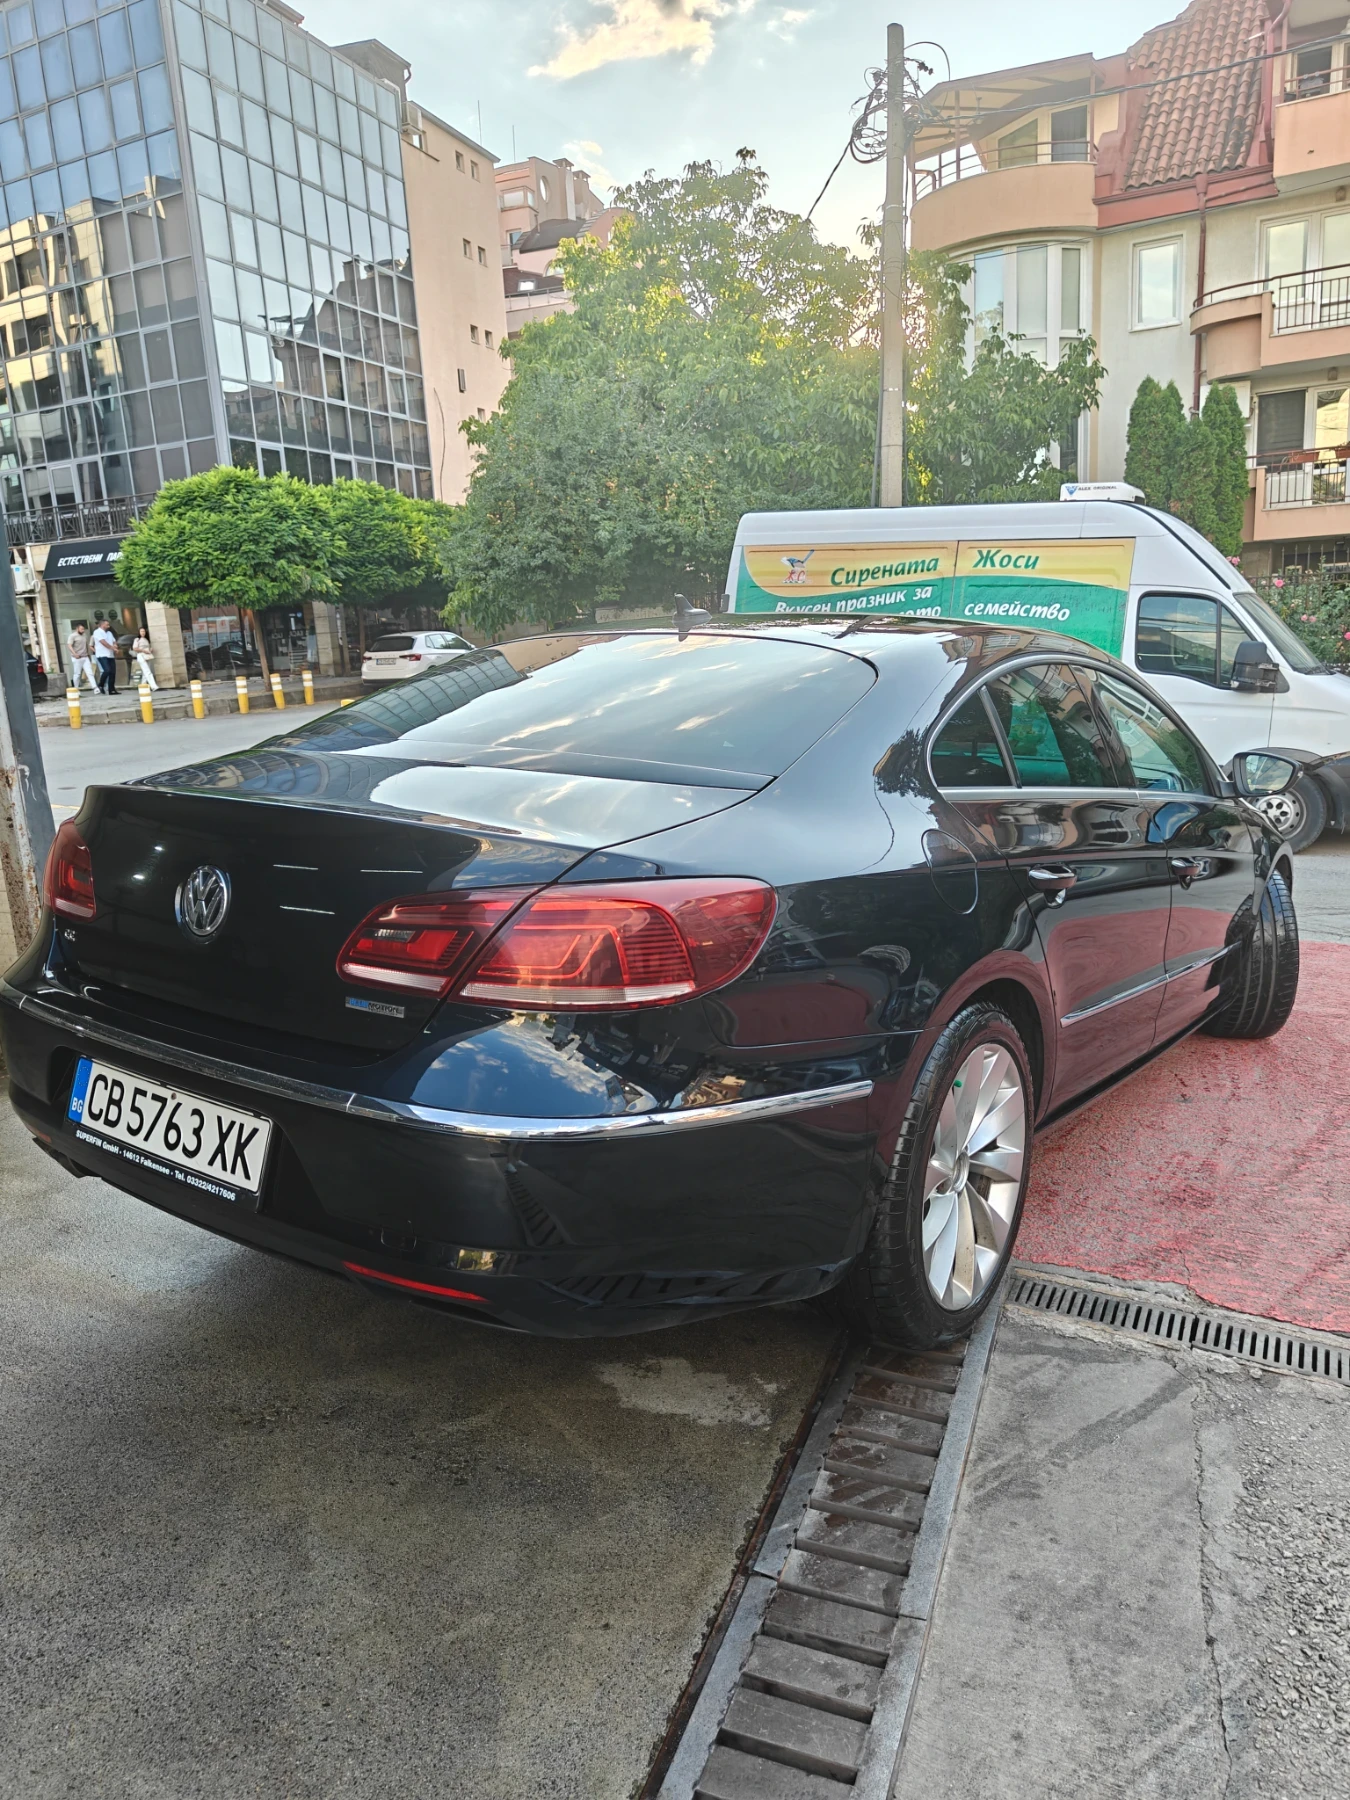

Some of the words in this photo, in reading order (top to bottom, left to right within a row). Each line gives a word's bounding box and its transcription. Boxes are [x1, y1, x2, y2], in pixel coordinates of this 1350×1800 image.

[57, 553, 103, 567] ЕСТЕСТВЕНИ
[106, 551, 125, 562] ПАР
[830, 557, 939, 587] Сирената
[972, 549, 1040, 569] Жоси
[836, 590, 907, 613] празник
[912, 586, 932, 600] за
[964, 600, 1070, 621] семейство
[71, 1097, 83, 1113] BG
[75, 1129, 102, 1148] SUPERFIN
[102, 1140, 119, 1155] GmbH
[122, 1149, 140, 1164] 14612
[140, 1155, 170, 1175] Falkensee
[174, 1169, 185, 1182] Tel.
